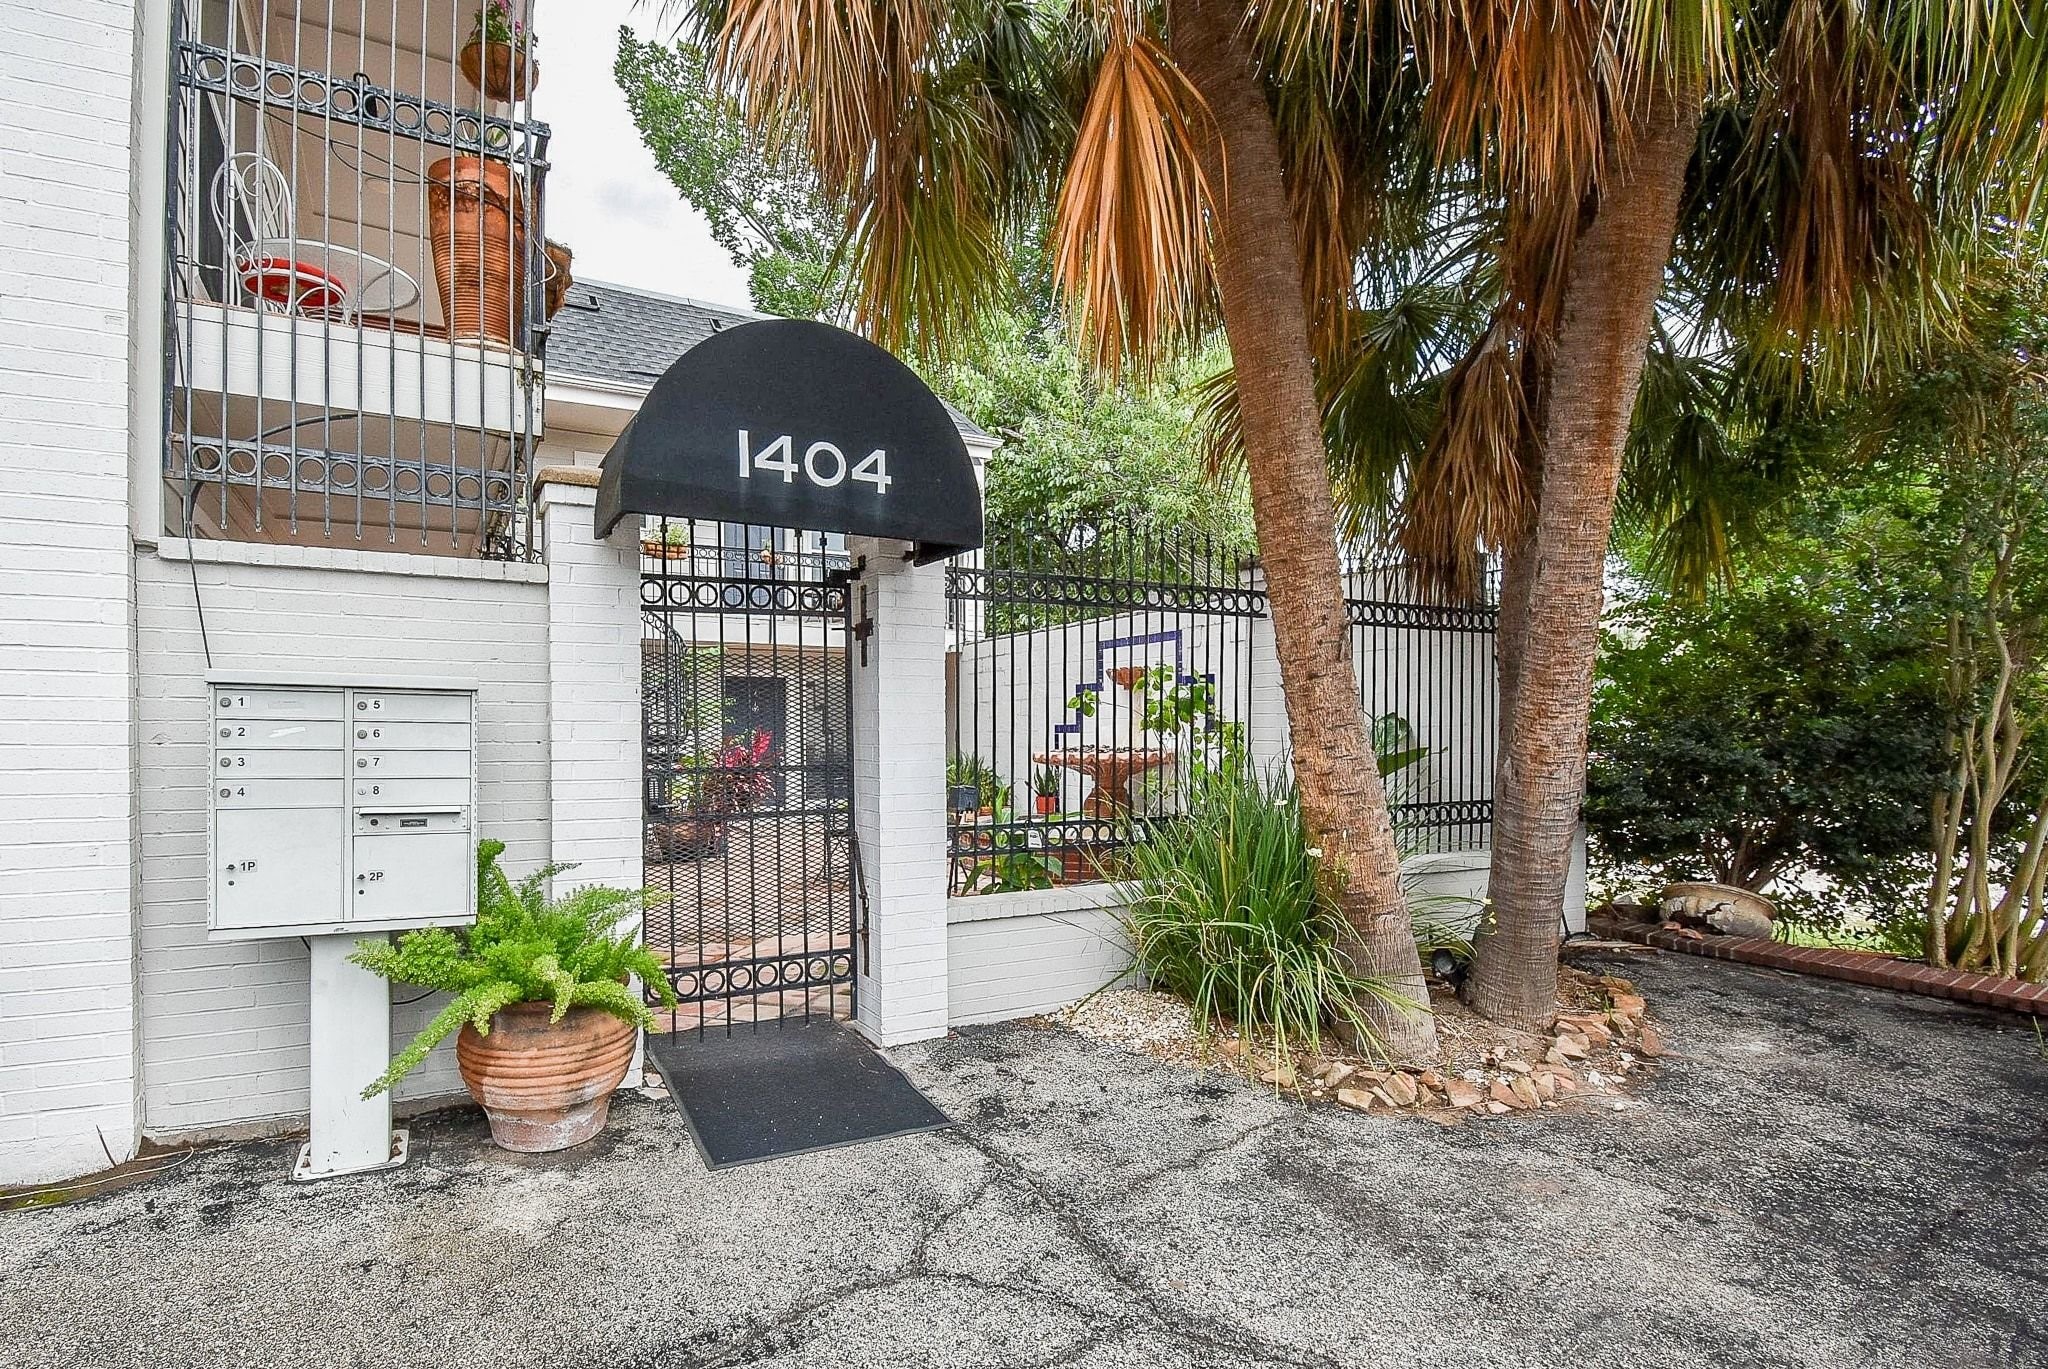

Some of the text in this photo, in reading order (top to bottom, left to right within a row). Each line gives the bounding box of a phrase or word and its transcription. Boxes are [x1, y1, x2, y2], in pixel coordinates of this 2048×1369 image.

[738, 429, 892, 495] 1404
[237, 696, 244, 707] 1
[373, 700, 381, 710] 5
[237, 727, 246, 737] 2
[372, 728, 381, 738] 6
[237, 757, 246, 767] 3
[372, 757, 380, 767] 7
[236, 787, 246, 797] 4
[372, 785, 380, 795] 8
[240, 861, 256, 872] 1P
[369, 871, 384, 882] 2P
